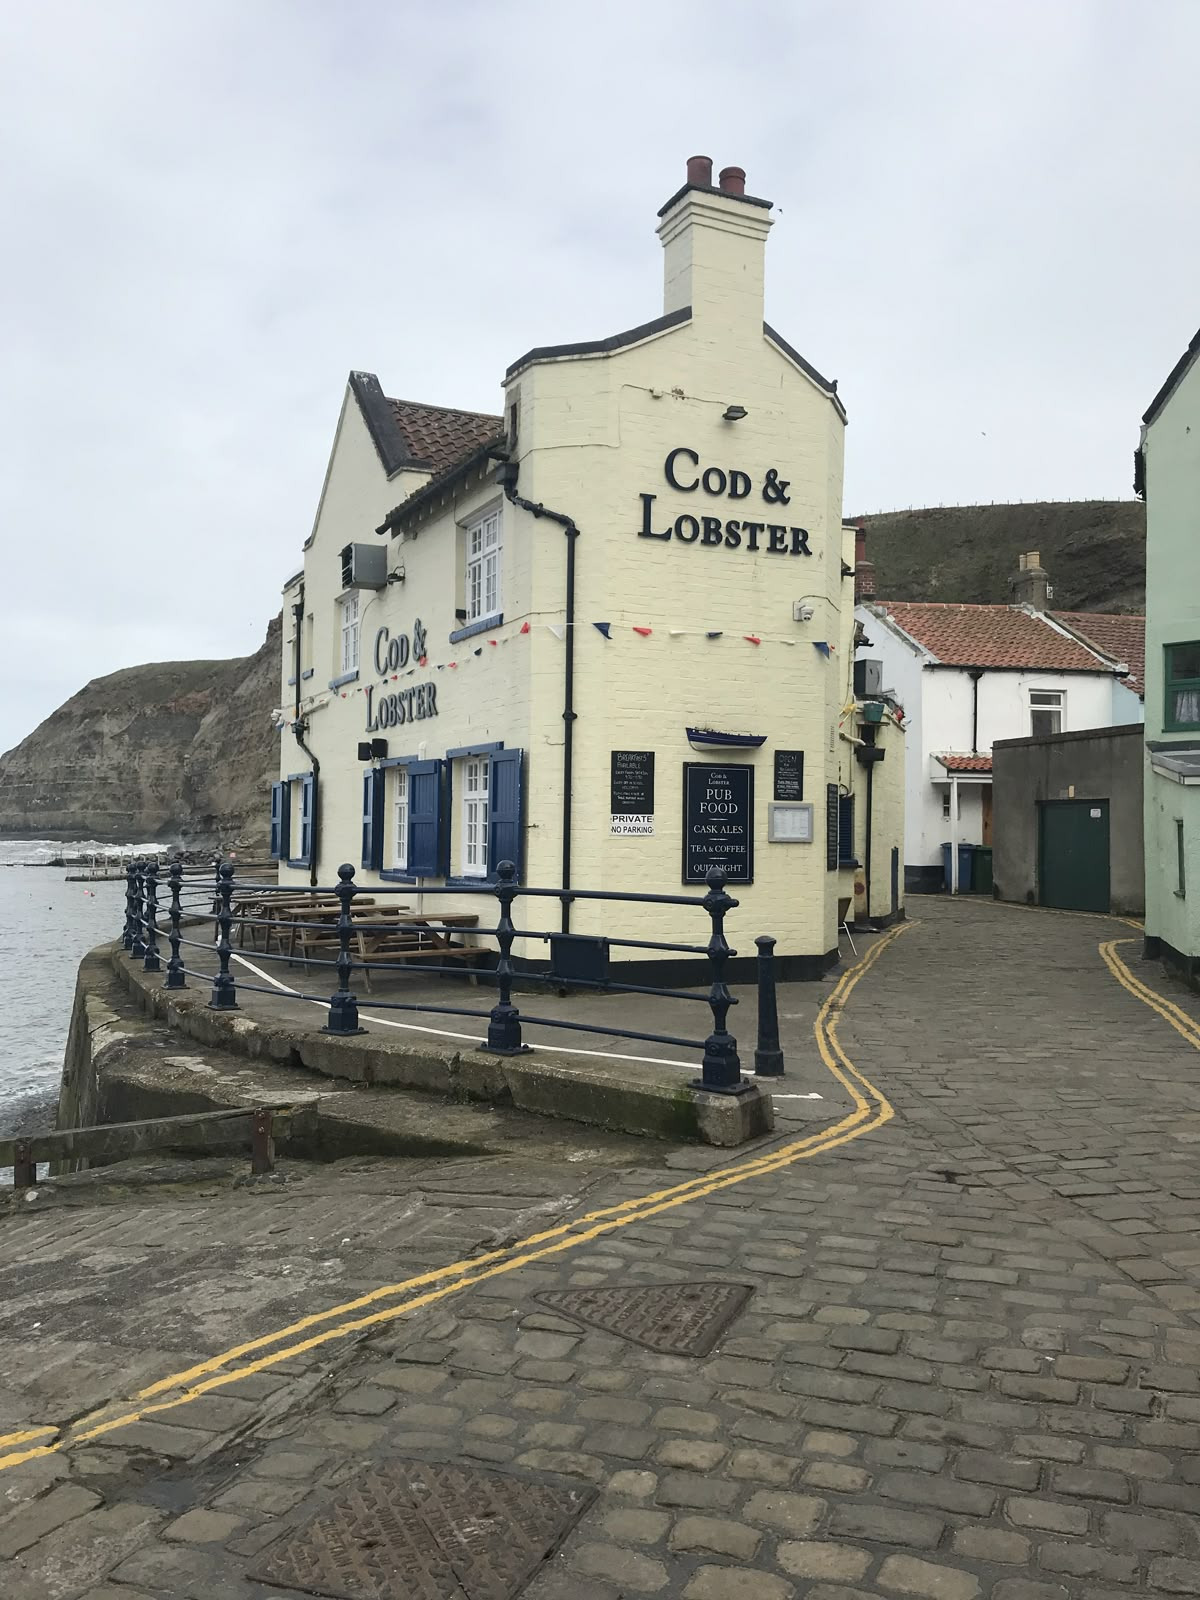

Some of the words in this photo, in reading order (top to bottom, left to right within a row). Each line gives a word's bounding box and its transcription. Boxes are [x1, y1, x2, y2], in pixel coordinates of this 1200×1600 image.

[762, 468, 791, 505] &
[637, 492, 813, 556] LOBSTER
[412, 618, 428, 662] &
[365, 682, 439, 732] LOBSTER
[706, 788, 732, 801] PUB
[700, 802, 738, 814] FOOD
[612, 815, 653, 823] PRIVATE
[611, 825, 622, 834] NO
[623, 826, 653, 834] PARKING
[693, 824, 718, 834] CASK
[720, 825, 744, 834] ALES
[690, 844, 707, 853] TEA
[714, 845, 746, 853] COFFEE
[693, 864, 714, 873] QUIZ
